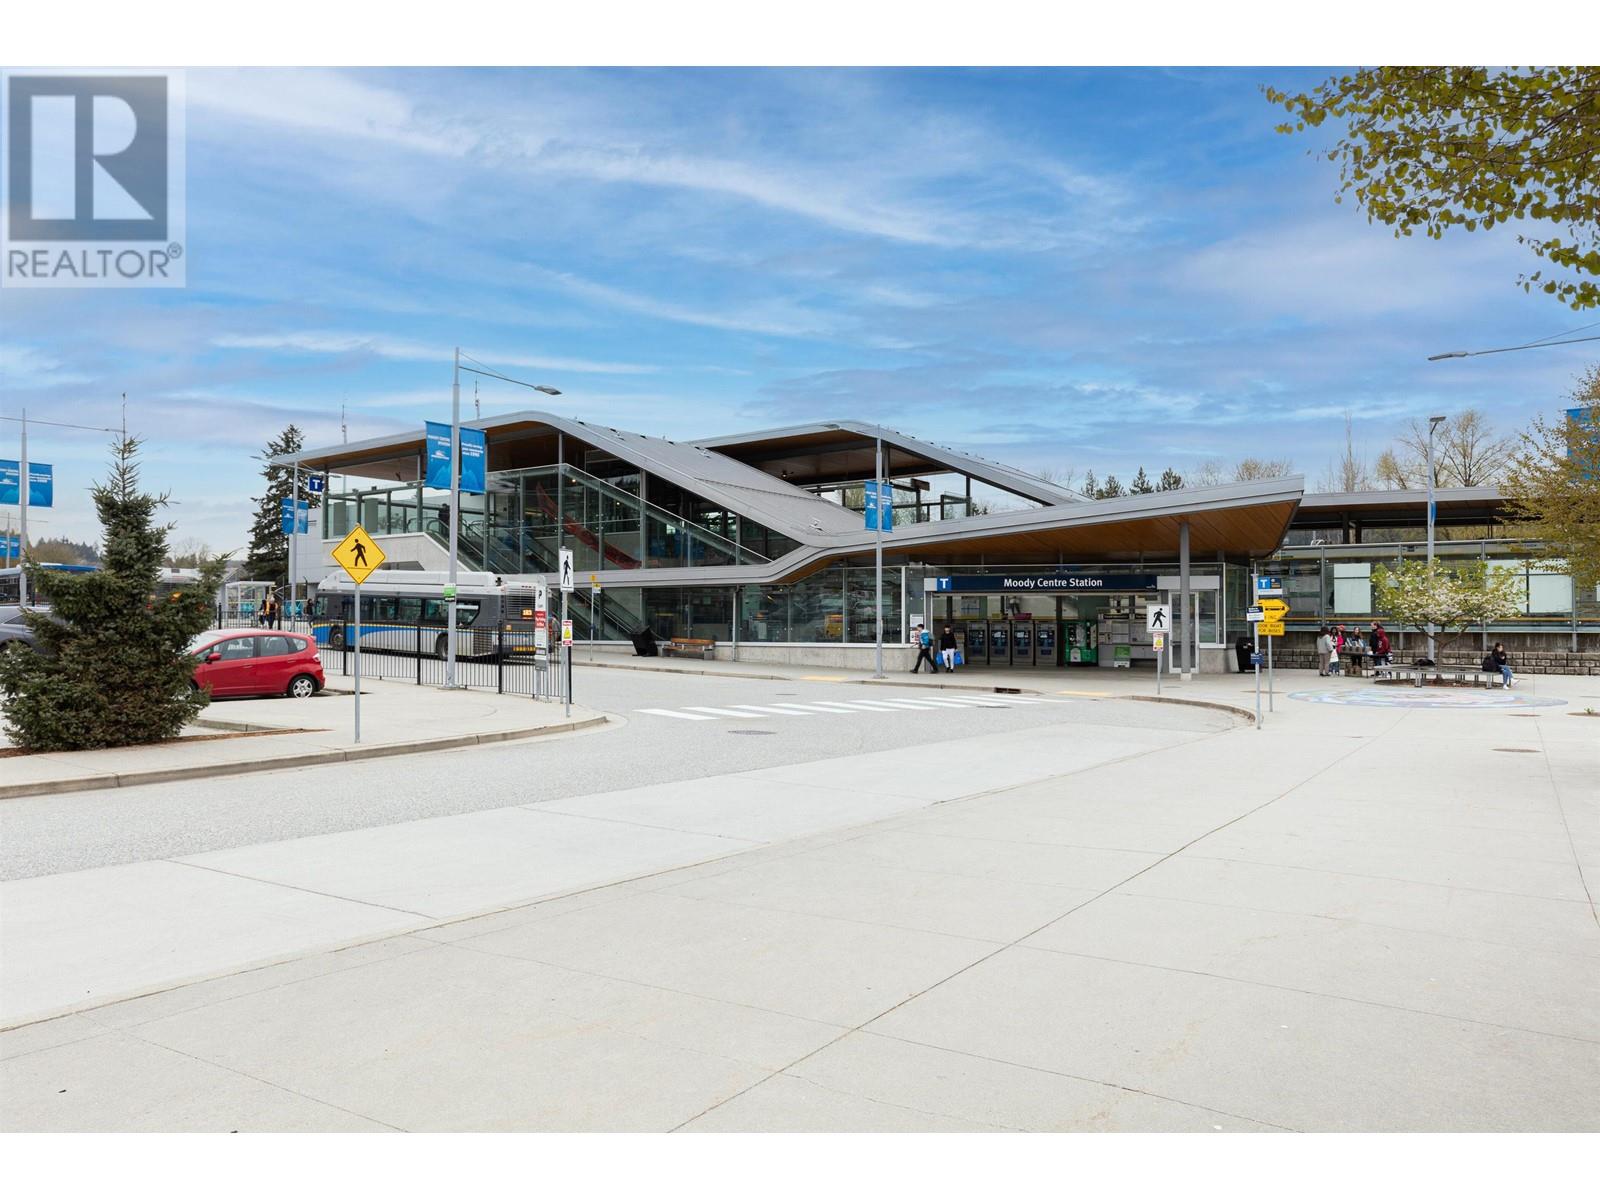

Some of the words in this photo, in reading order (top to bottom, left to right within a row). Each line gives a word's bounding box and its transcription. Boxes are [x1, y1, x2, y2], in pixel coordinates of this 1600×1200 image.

[312, 479, 320, 489] T
[940, 578, 948, 589] T
[1004, 578, 1035, 589] Moody
[1037, 578, 1067, 588] Centre
[1069, 578, 1102, 588] Station
[1260, 579, 1268, 588] T
